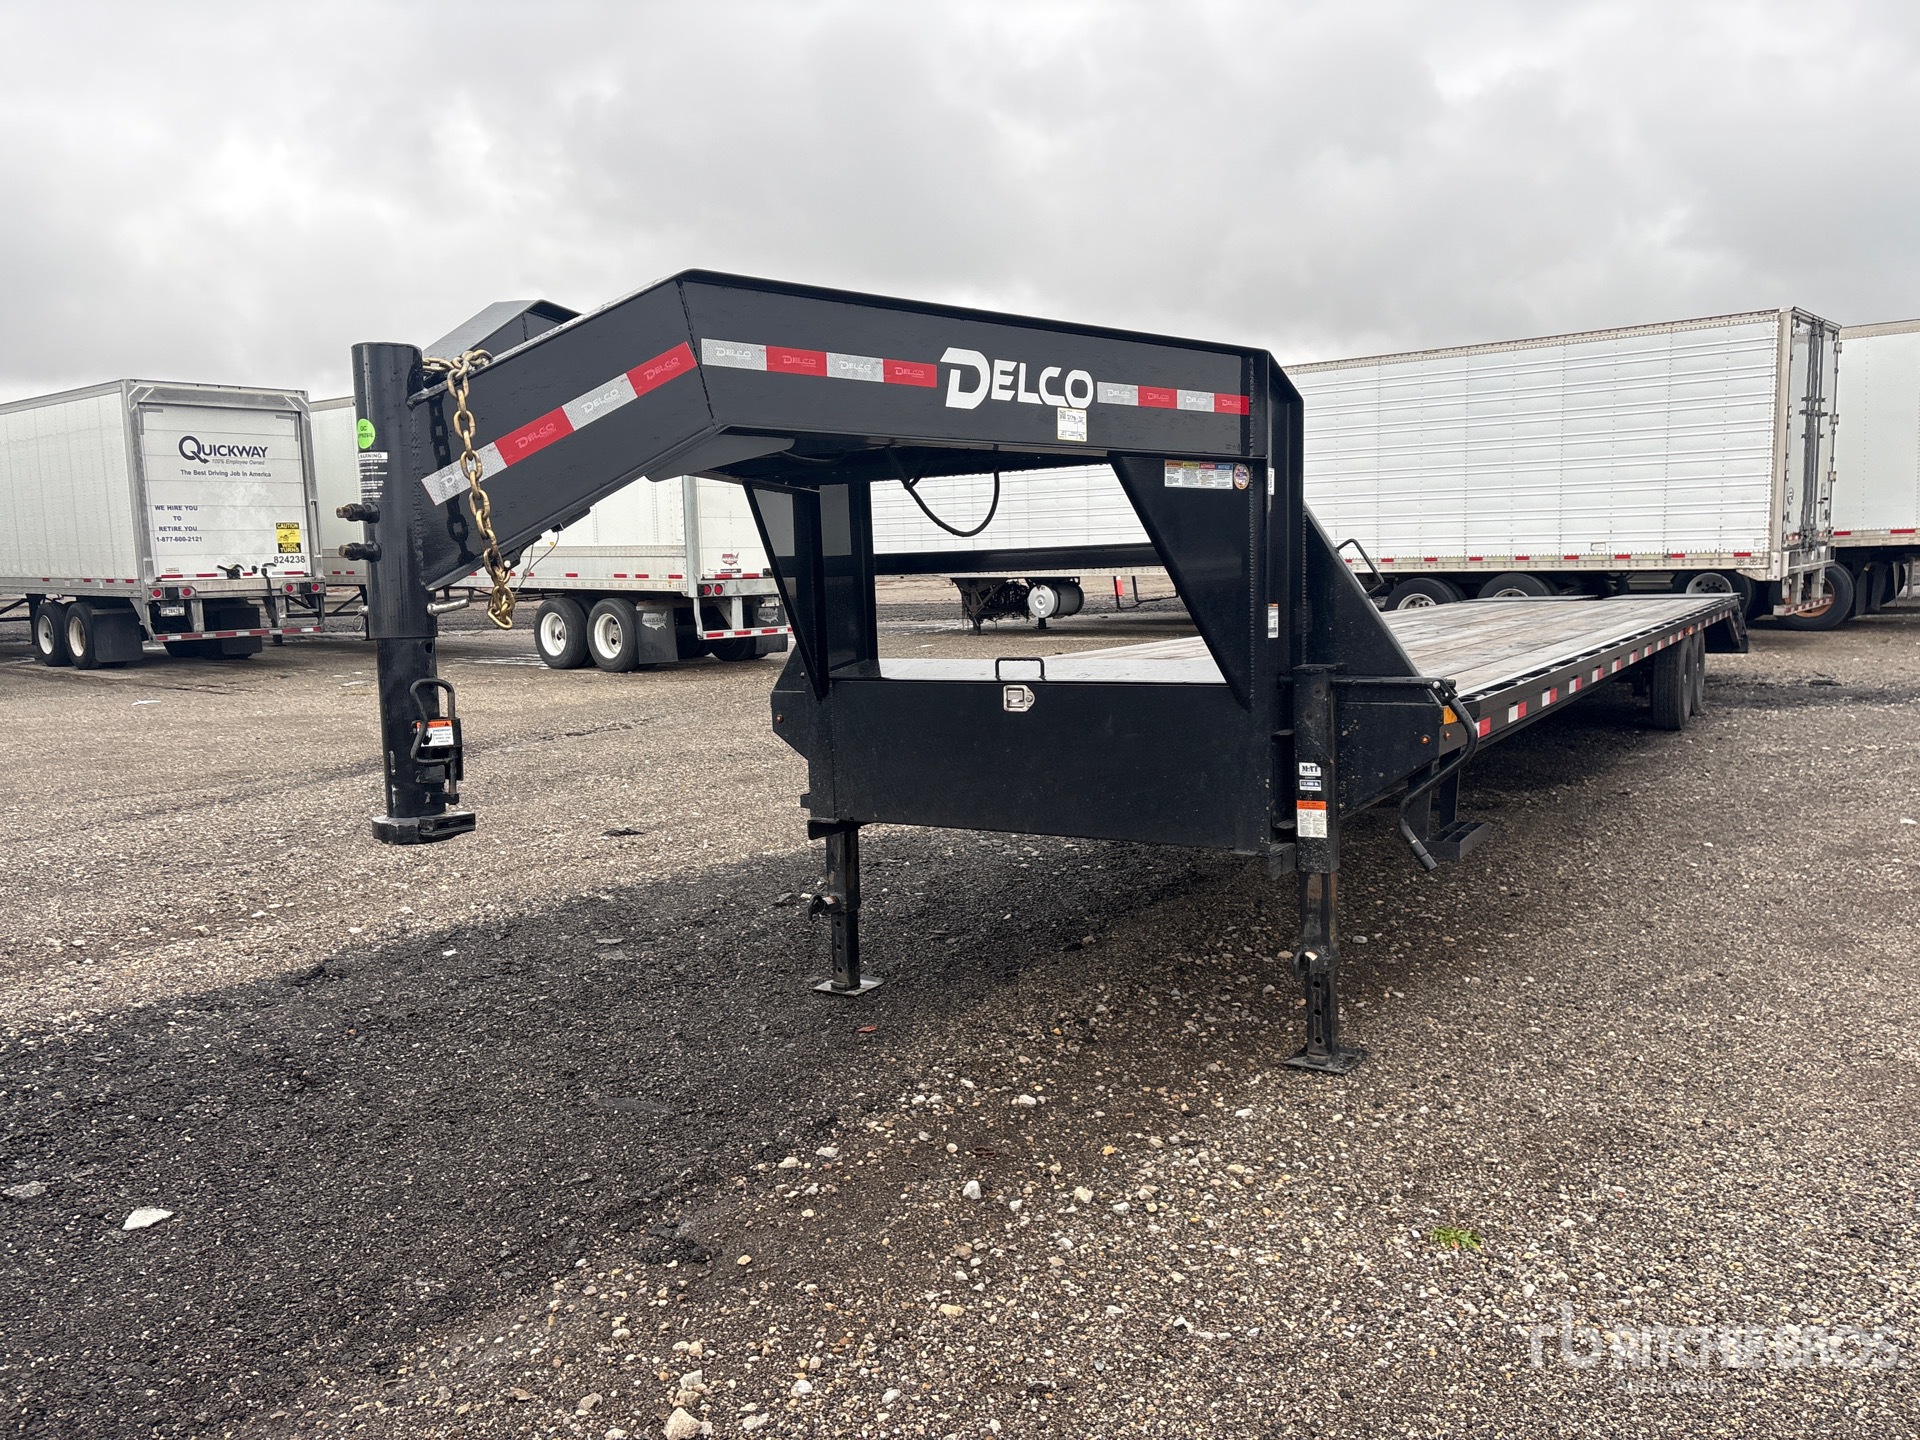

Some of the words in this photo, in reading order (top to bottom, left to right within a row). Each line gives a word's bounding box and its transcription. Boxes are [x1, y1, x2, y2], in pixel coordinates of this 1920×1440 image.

[714, 347, 752, 358] DELCO
[782, 355, 817, 365] DELCO
[839, 360, 872, 371] DELCO
[644, 356, 680, 381] DELCO
[894, 366, 925, 376] DELCO
[940, 347, 1094, 410] DELCO
[580, 388, 619, 413] DELCO
[514, 422, 556, 449] DELCO
[178, 435, 269, 464] QUICKWAY
[208, 470, 229, 478] Driving
[273, 555, 306, 564] 824238
